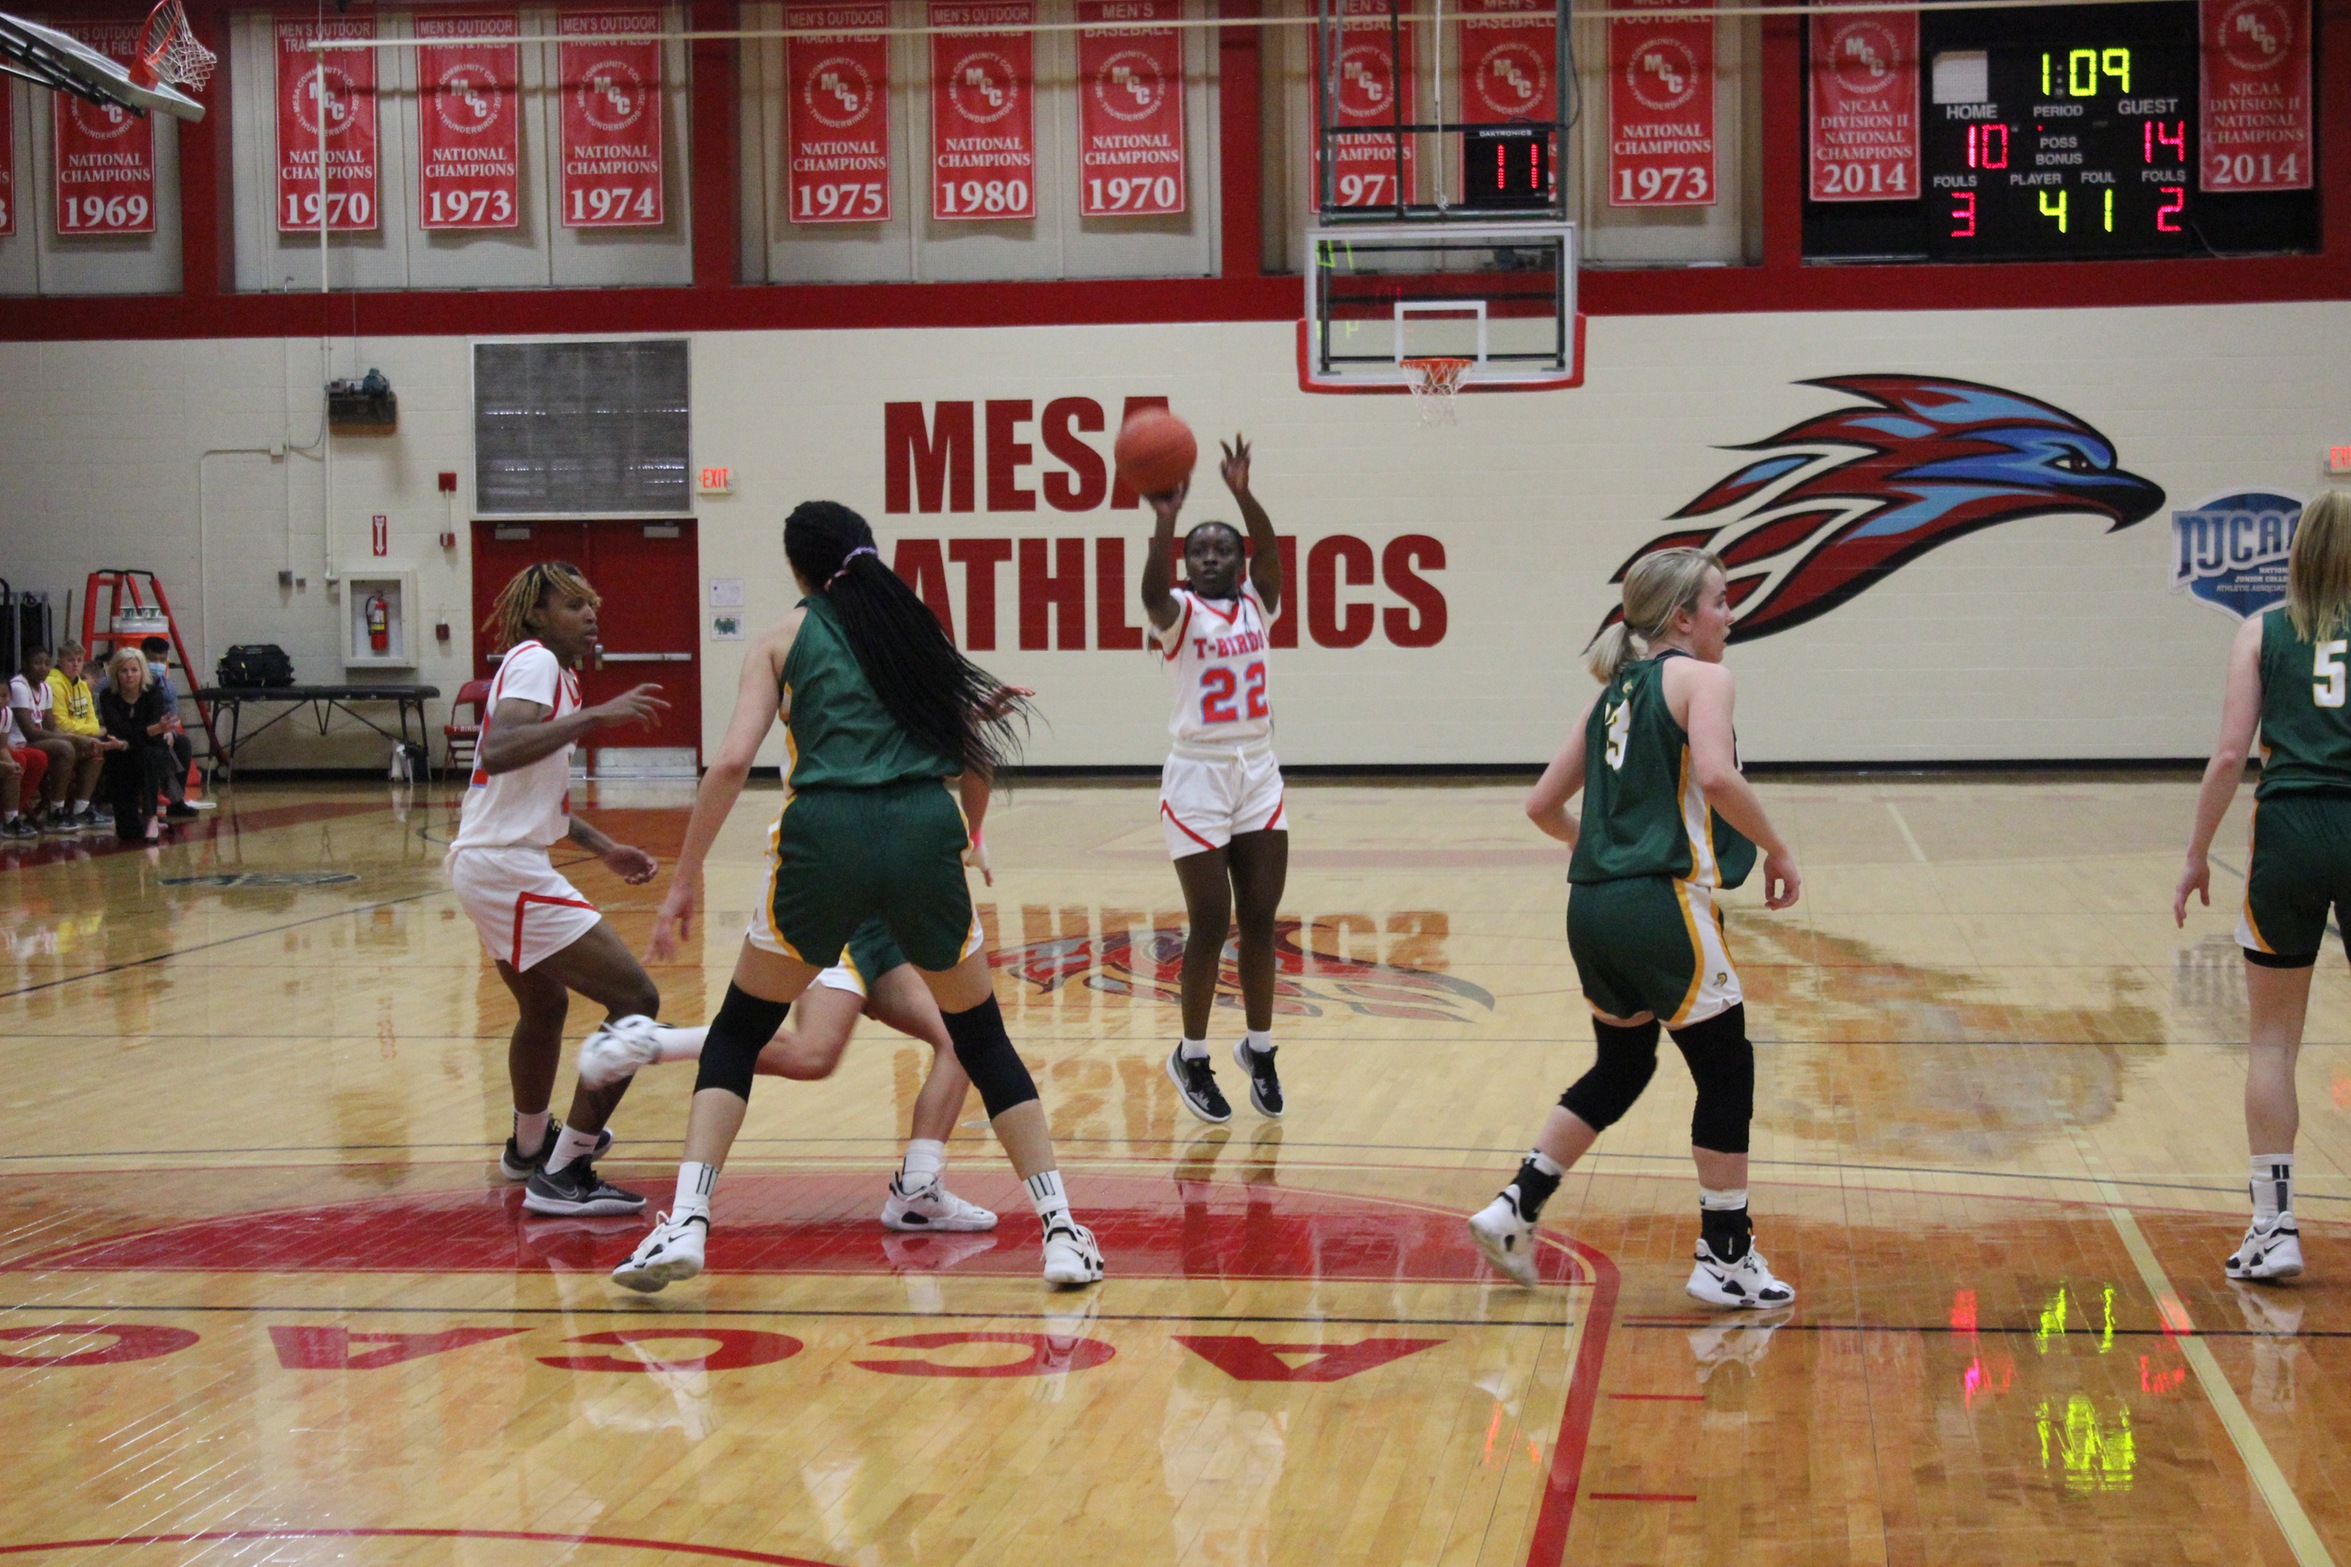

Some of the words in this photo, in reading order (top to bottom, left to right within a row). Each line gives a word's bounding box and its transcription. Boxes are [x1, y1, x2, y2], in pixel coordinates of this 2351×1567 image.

[790, 12, 824, 26] MEN'S
[828, 10, 884, 25] OUTDOOR
[935, 8, 970, 23] MEN'S
[972, 6, 1029, 21] OUTDOOR
[1102, 2, 1154, 18] MEN'S
[279, 24, 313, 37] MEN'S
[316, 22, 371, 37] OUTDOOR
[420, 20, 455, 34] MEN'S
[458, 19, 513, 33] OUTDOOR
[563, 17, 598, 31] MEN'S
[600, 15, 656, 30] OUTDOOR
[92, 25, 143, 39] OUTDOO
[2236, 14, 2277, 54] MCC
[1845, 37, 1885, 77] MCC
[298, 66, 342, 88] COMMNITY
[1344, 61, 1382, 101] MCC
[1493, 58, 1532, 98] MCC
[1644, 53, 1684, 94] MCC
[821, 73, 858, 111] MCC
[966, 68, 1003, 107] MCC
[1112, 66, 1150, 105] MCC
[2229, 82, 2281, 97] NJCAA
[451, 79, 488, 118] MCC
[594, 76, 630, 115] MCC
[1839, 99, 1889, 113] NJCAA
[1946, 103, 1998, 120] HOME
[2033, 104, 2084, 118] PERIOD
[2118, 98, 2179, 115] GUEST
[2210, 97, 2284, 112] DIVISION
[298, 115, 356, 137] THUNERBIRDS
[1821, 115, 1893, 129] DIVISION
[2214, 113, 2297, 128] NATIONAL
[1328, 132, 1396, 145] ATIONA
[1479, 129, 1533, 138] DAKTRONICS
[1623, 124, 1703, 139] NATIONAL
[1824, 131, 1905, 144] NATIONAL
[2206, 128, 2305, 144] CHAMPIONS
[800, 140, 879, 156] NATIONAL
[945, 136, 1023, 151] NATIONAL
[1092, 134, 1171, 149] NATIONAL
[1614, 139, 1712, 155] CHAMPIONS
[1967, 122, 2009, 169] 10
[2144, 119, 2186, 164] 14
[2039, 136, 2078, 149] POSS
[289, 150, 365, 164] NATONAL
[432, 148, 507, 161] NATIONAL
[574, 144, 651, 159] NATIONAL
[1084, 150, 1179, 165] CHAMPIONS
[1817, 145, 1912, 161] CHAMPIONS
[2035, 153, 2083, 166] BONUS
[68, 153, 143, 167] NATIONAL
[567, 159, 658, 175] CHAMPIONS
[793, 156, 886, 172] CHAMPIONS
[938, 152, 1031, 168] CHAMPIONS
[1497, 143, 1539, 190] 11
[61, 168, 151, 183] CHAMPIONS
[425, 162, 515, 177] CHAMPIONS
[2212, 153, 2299, 184] 2014
[1619, 167, 1708, 200] 1973
[1823, 162, 1907, 194] 2014
[1933, 175, 1978, 188] FOULS
[2010, 172, 2063, 186] PLAYER
[2080, 171, 2117, 184] FOUL
[2141, 169, 2187, 183] FOULS
[798, 183, 882, 217] 1975
[942, 179, 1029, 213] 1980
[1089, 176, 1176, 210] 1970
[65, 195, 148, 228] 1969
[286, 193, 370, 225] 1970
[429, 190, 511, 222] 1973
[571, 187, 655, 220] 1974
[1950, 191, 1977, 238] 3
[2038, 189, 2068, 234] 4
[2156, 186, 2186, 232] 2
[2331, 445, 2351, 469] EX
[702, 468, 729, 489] EXIT
[2259, 567, 2288, 575] NATION
[2266, 575, 2288, 584] COLLE
[893, 534, 1448, 651] ATHLICS
[2312, 640, 2348, 709] 5
[1200, 660, 1269, 725] 22
[1604, 699, 1631, 771] 3
